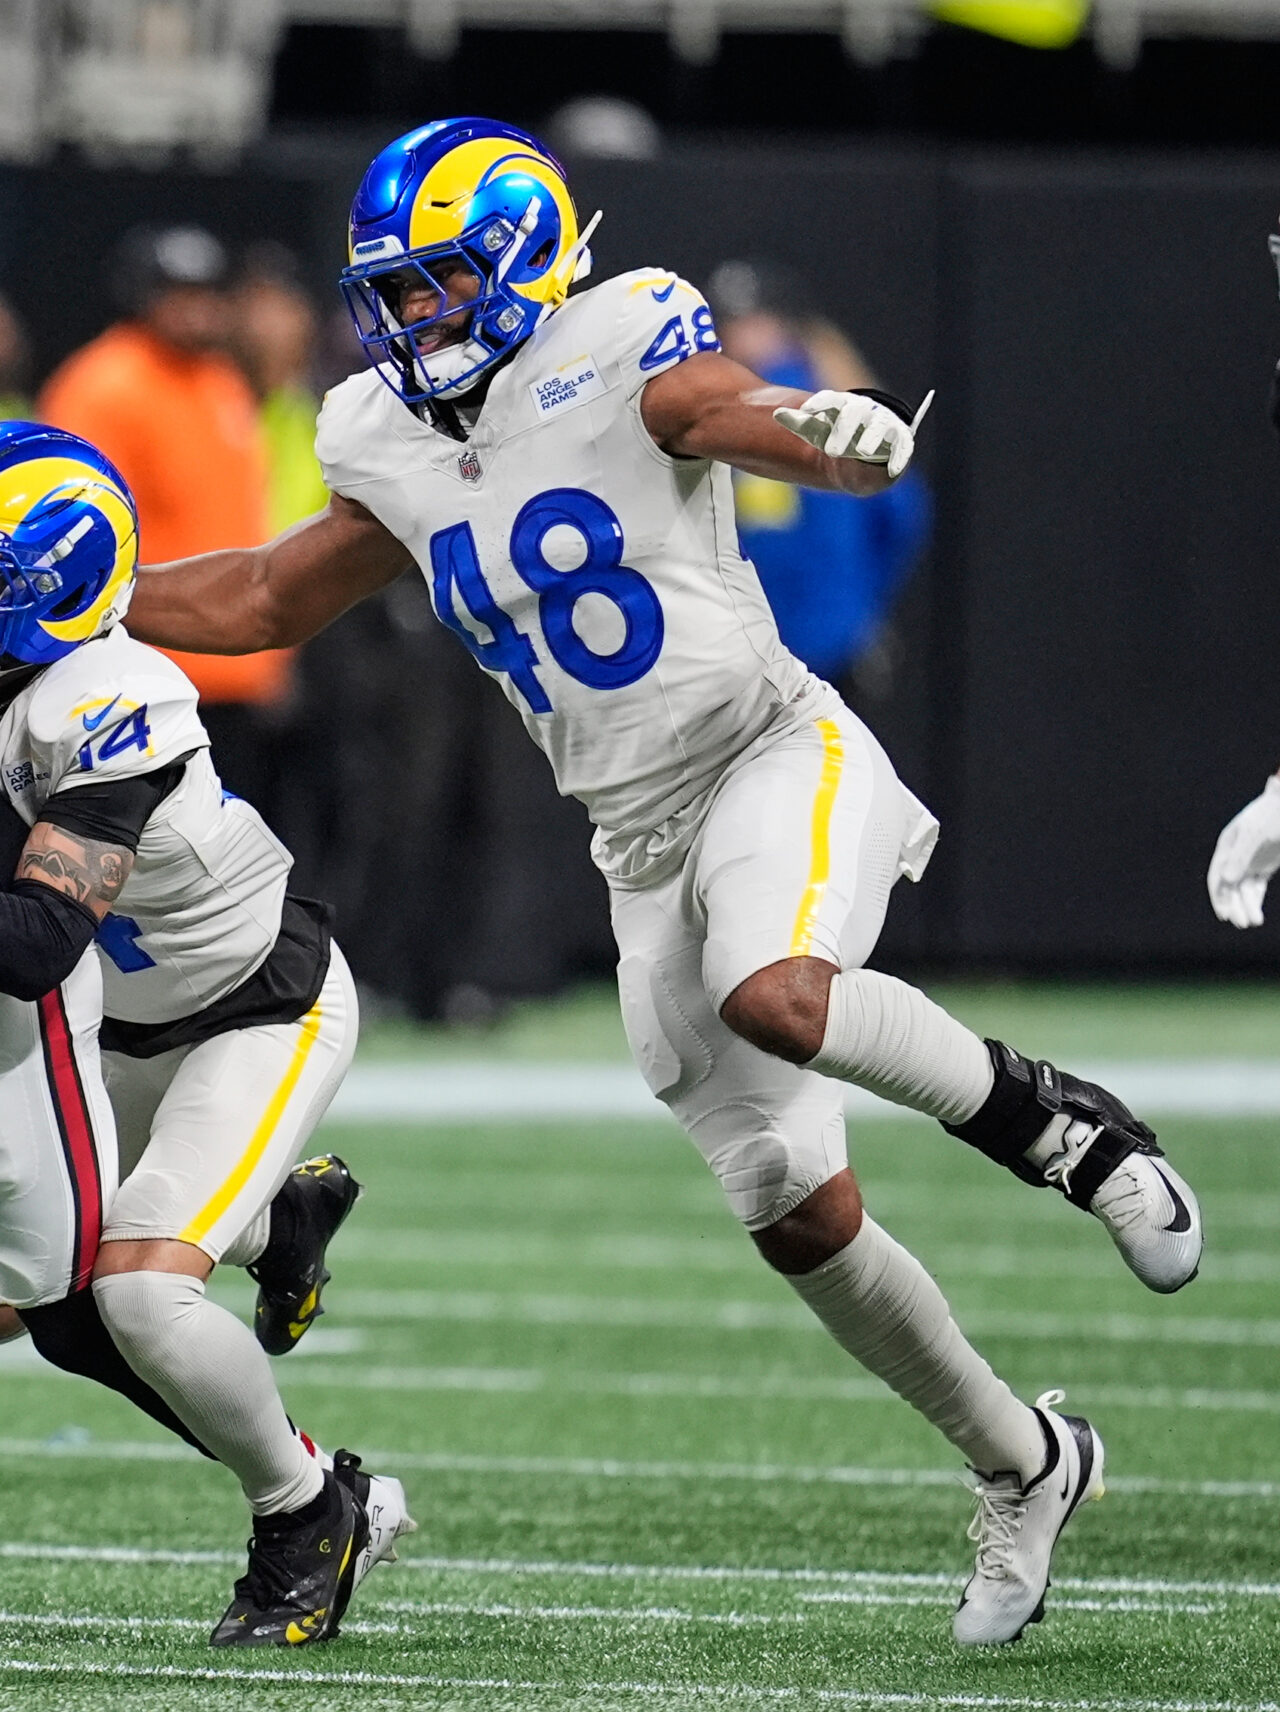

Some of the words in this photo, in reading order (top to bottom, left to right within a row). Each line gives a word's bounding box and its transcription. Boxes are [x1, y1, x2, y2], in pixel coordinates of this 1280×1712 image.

[638, 305, 722, 372] 48
[536, 377, 562, 395] LOS
[539, 370, 595, 403] ANGELES
[541, 388, 578, 411] RAMS
[429, 487, 664, 715] 48
[79, 702, 151, 771] 14
[6, 761, 32, 778] LOS
